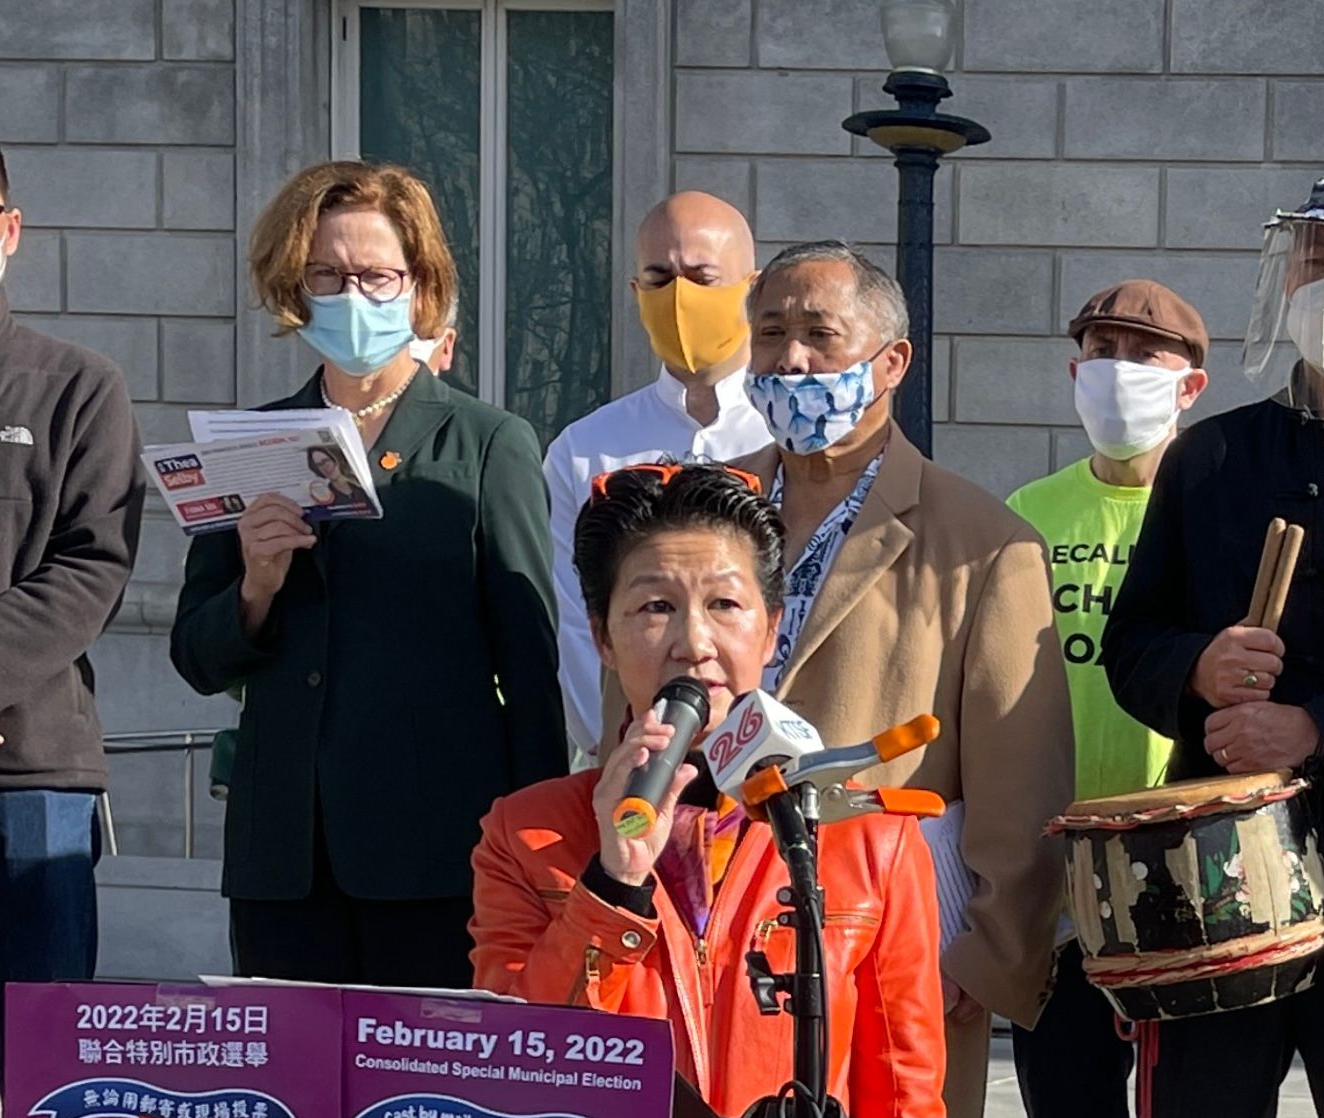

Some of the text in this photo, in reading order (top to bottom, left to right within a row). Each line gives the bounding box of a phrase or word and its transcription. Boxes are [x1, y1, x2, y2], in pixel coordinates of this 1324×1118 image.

[167, 457, 196, 473] Thea
[709, 701, 764, 776] 26
[76, 1003, 269, 1034] 2022年2月15日
[77, 1038, 269, 1068] 聯合特別市政選舉
[357, 1018, 644, 1065] February 15, 2022
[355, 1054, 642, 1090] Consolidated Special Municipal Election
